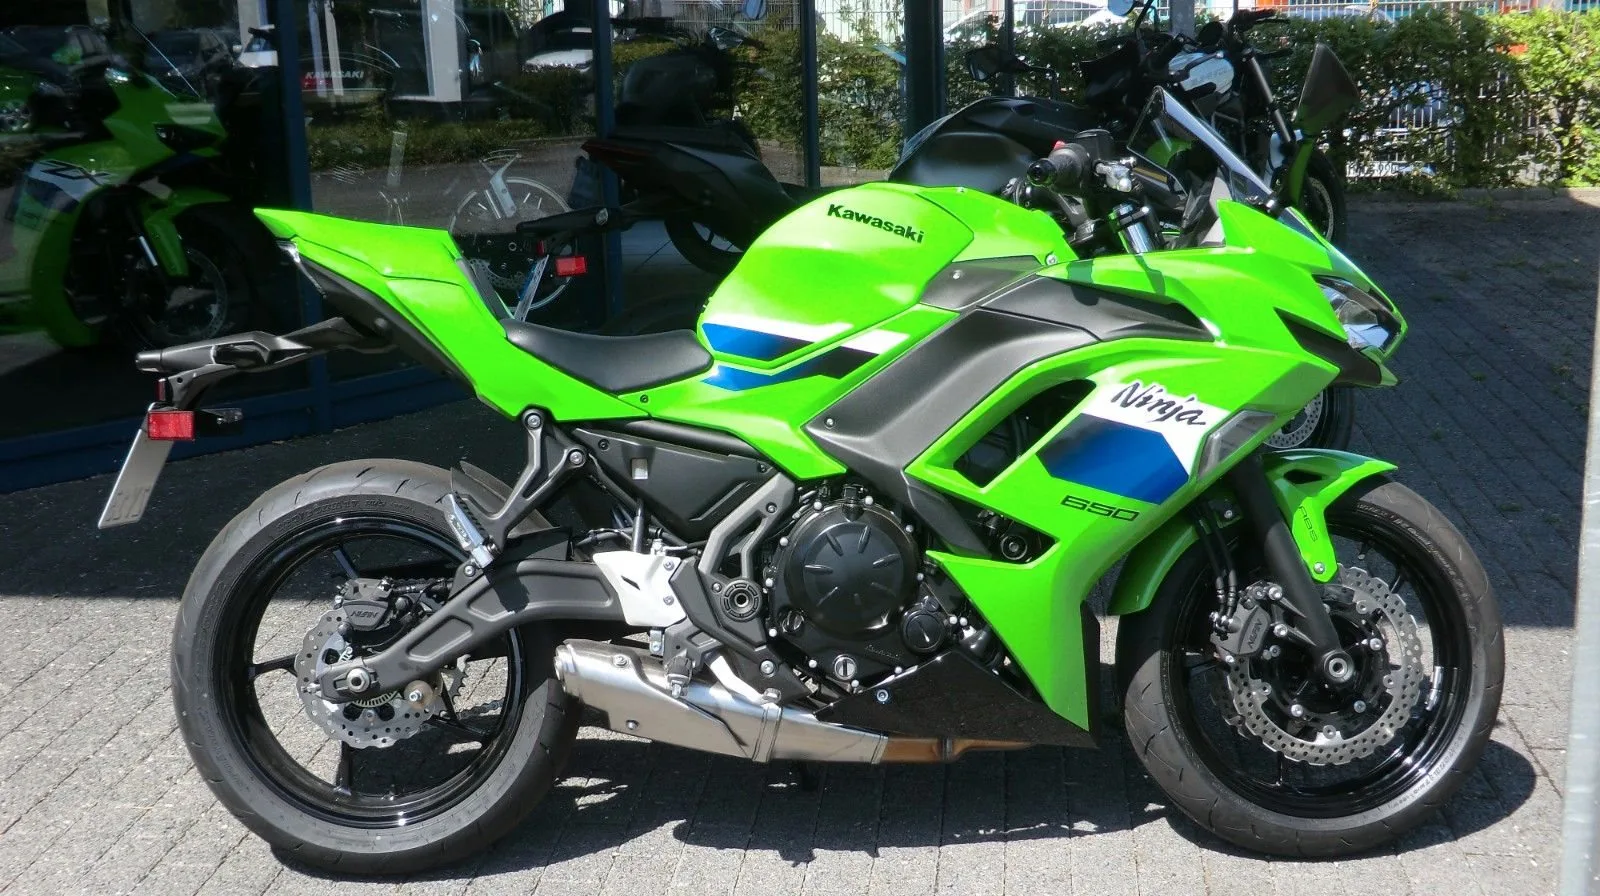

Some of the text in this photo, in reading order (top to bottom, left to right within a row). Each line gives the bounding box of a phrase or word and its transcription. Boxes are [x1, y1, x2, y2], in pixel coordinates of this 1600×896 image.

[827, 204, 924, 243] Kawasaki
[1110, 382, 1206, 425] Ninja
[1060, 495, 1140, 521] 650
[1299, 506, 1318, 542] ABS
